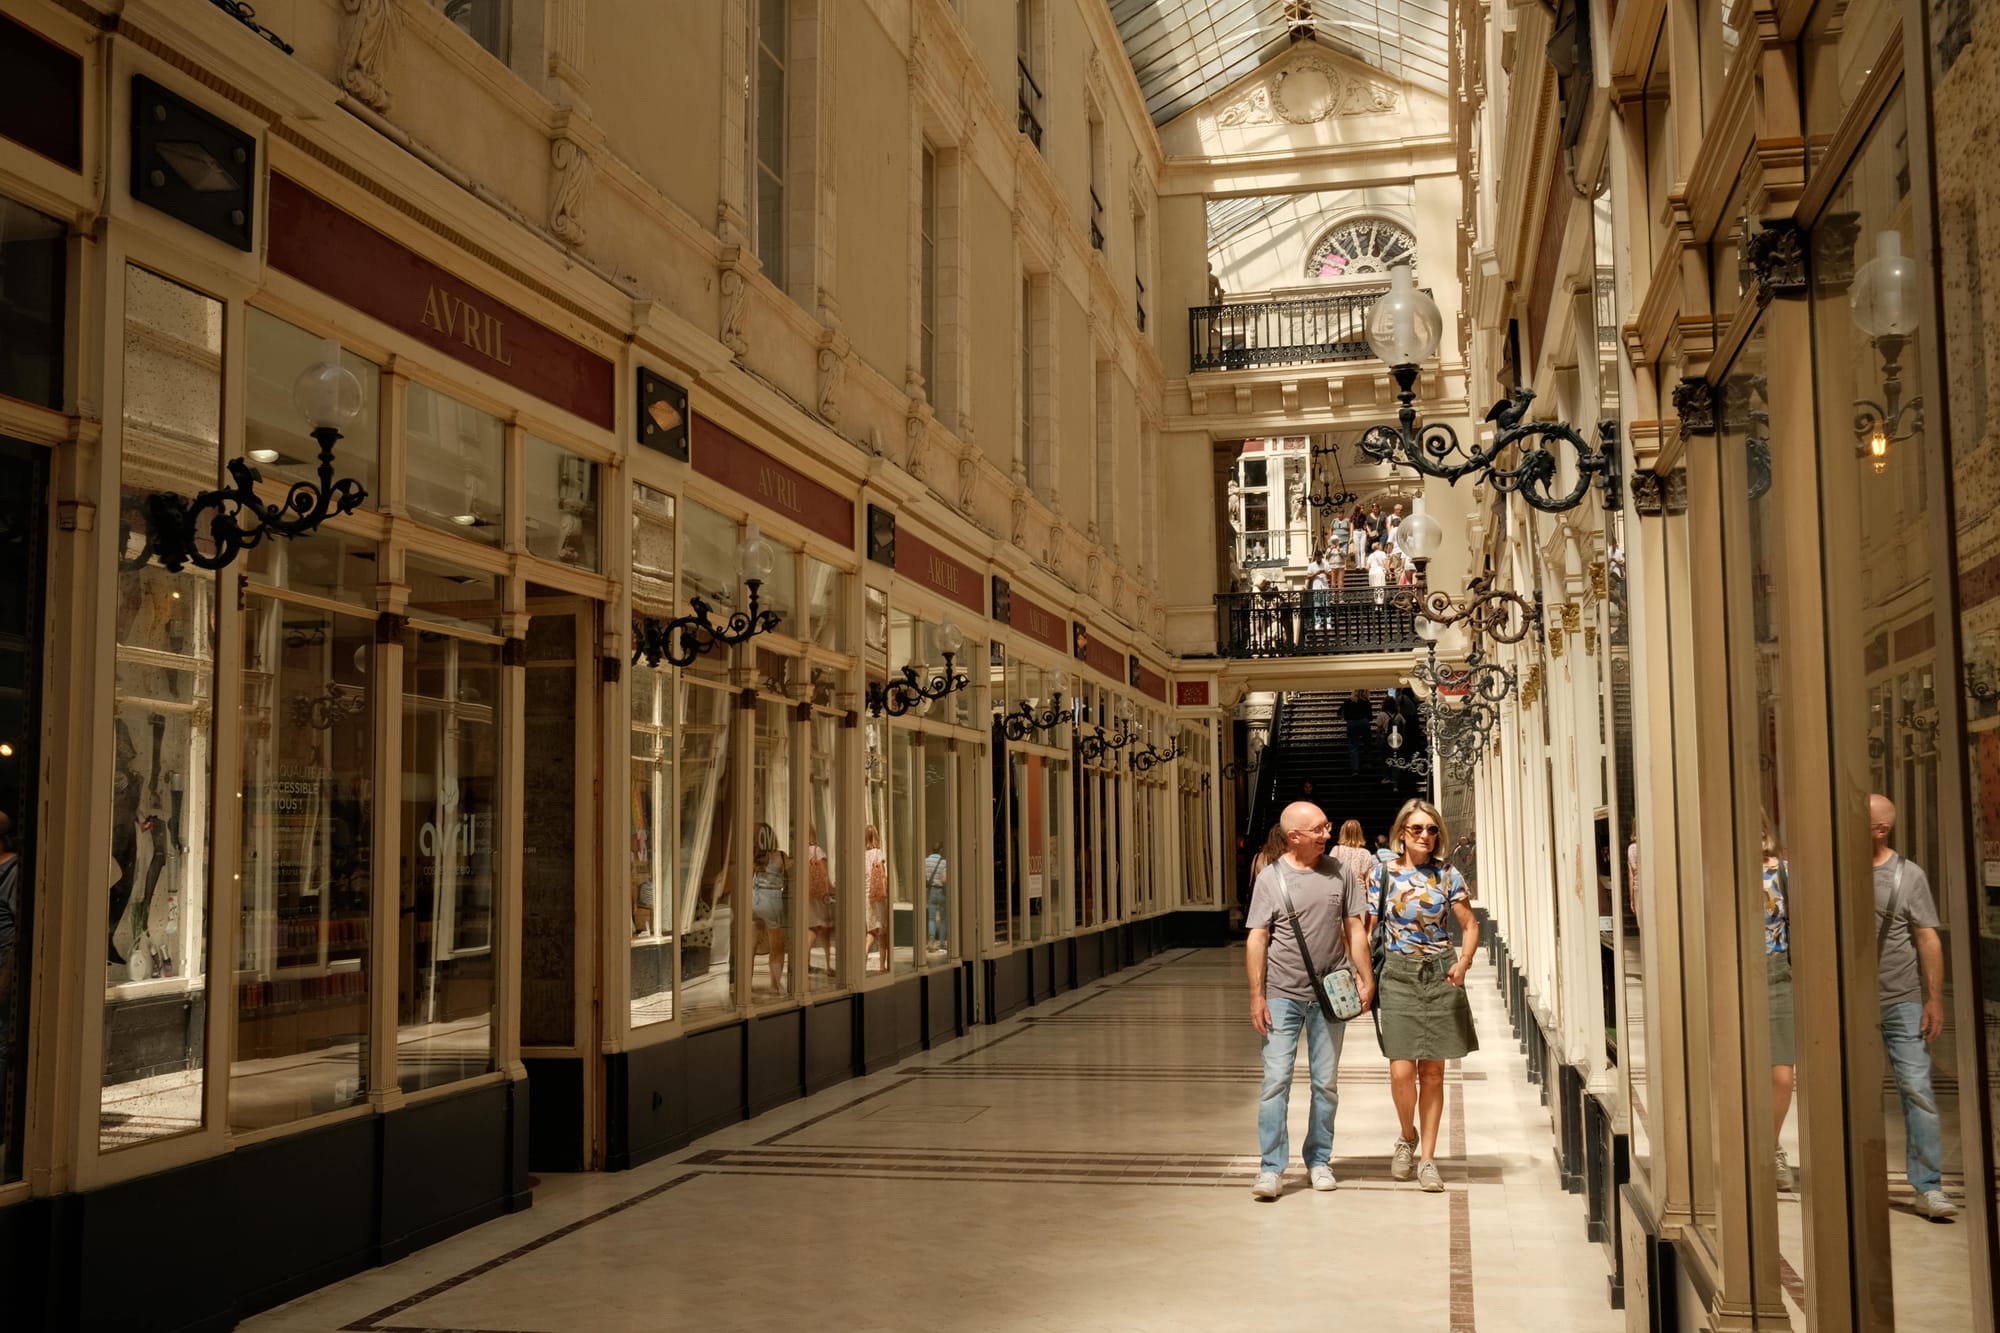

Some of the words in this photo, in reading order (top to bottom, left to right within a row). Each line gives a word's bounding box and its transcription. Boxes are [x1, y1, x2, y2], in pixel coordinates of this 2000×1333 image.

[420, 283, 512, 367] AVRIL
[758, 464, 801, 512] AVRIL
[927, 554, 960, 594] ARCHE
[273, 798, 297, 810] TOUS
[419, 813, 475, 856] avril
